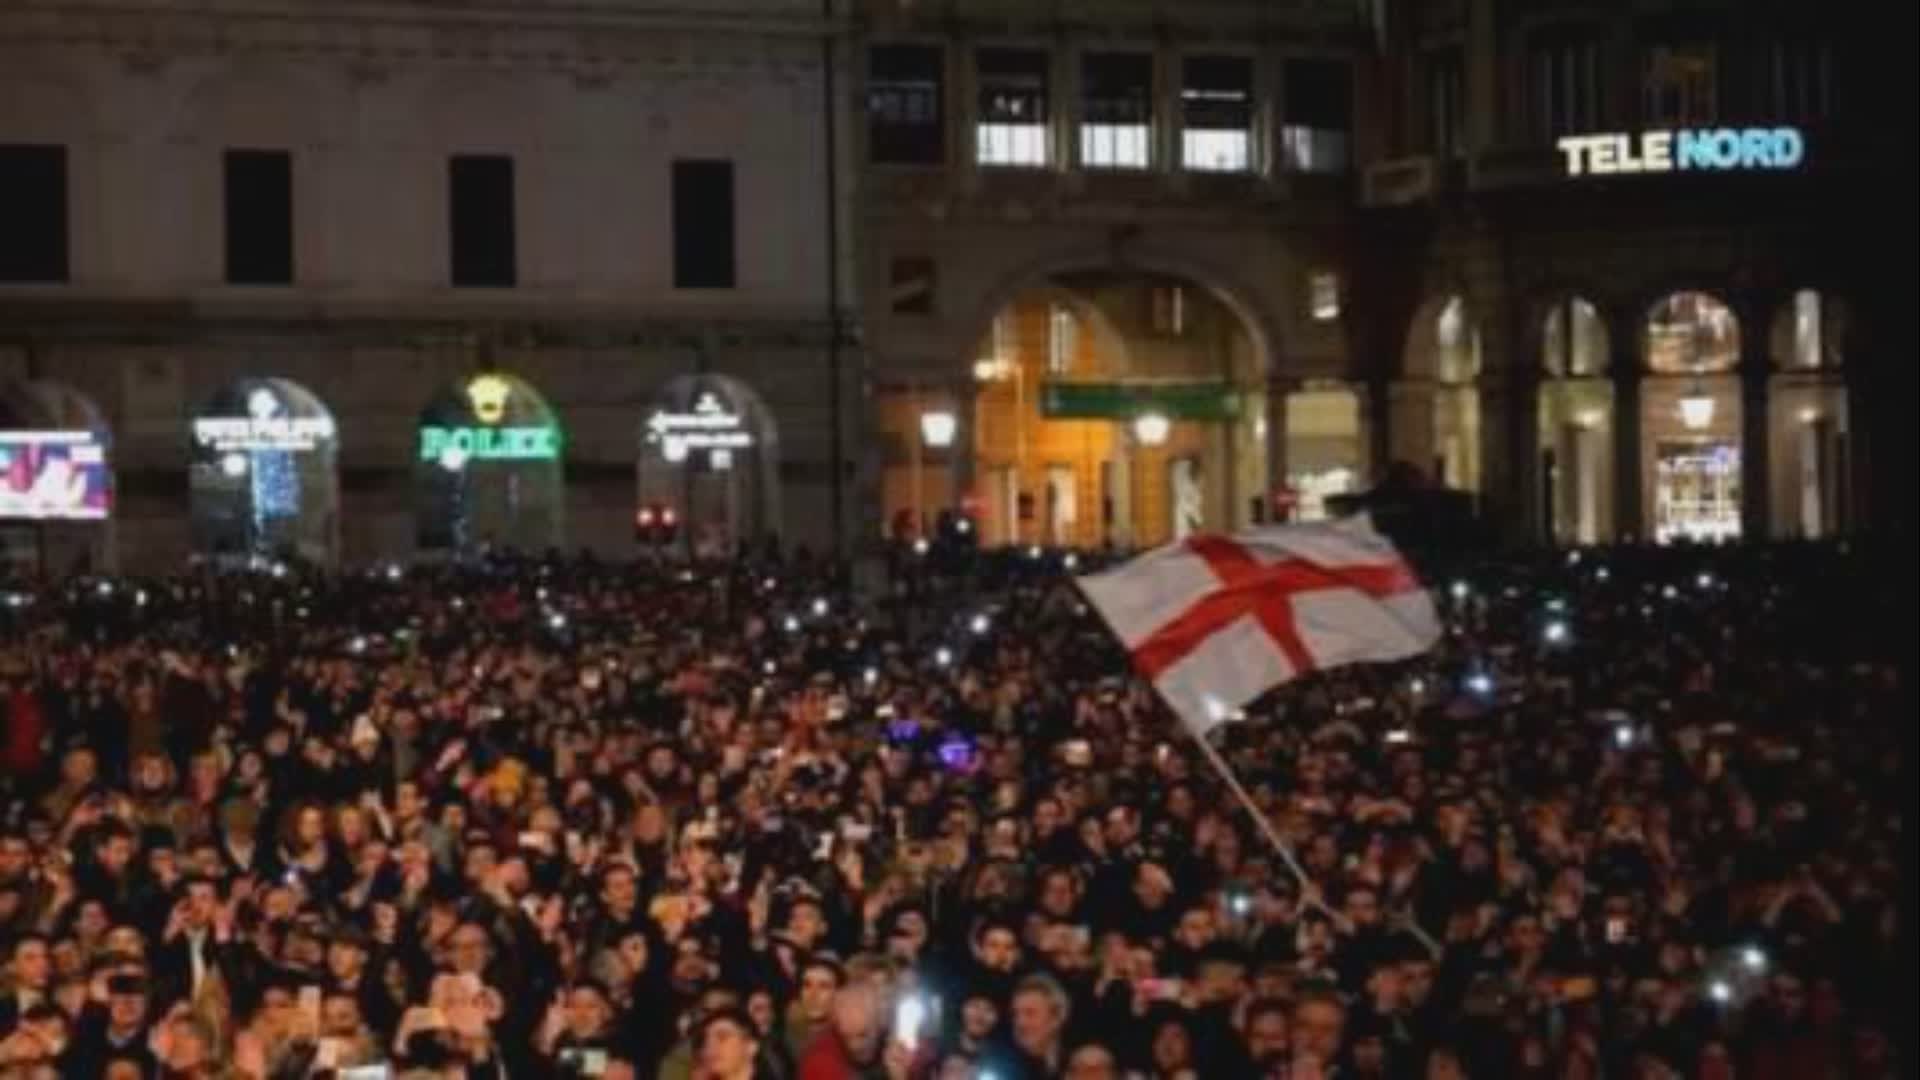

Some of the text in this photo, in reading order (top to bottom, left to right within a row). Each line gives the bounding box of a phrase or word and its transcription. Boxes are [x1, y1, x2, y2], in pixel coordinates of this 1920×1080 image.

[1557, 126, 1803, 175] TELE NORD
[420, 426, 558, 460] ROLEX
